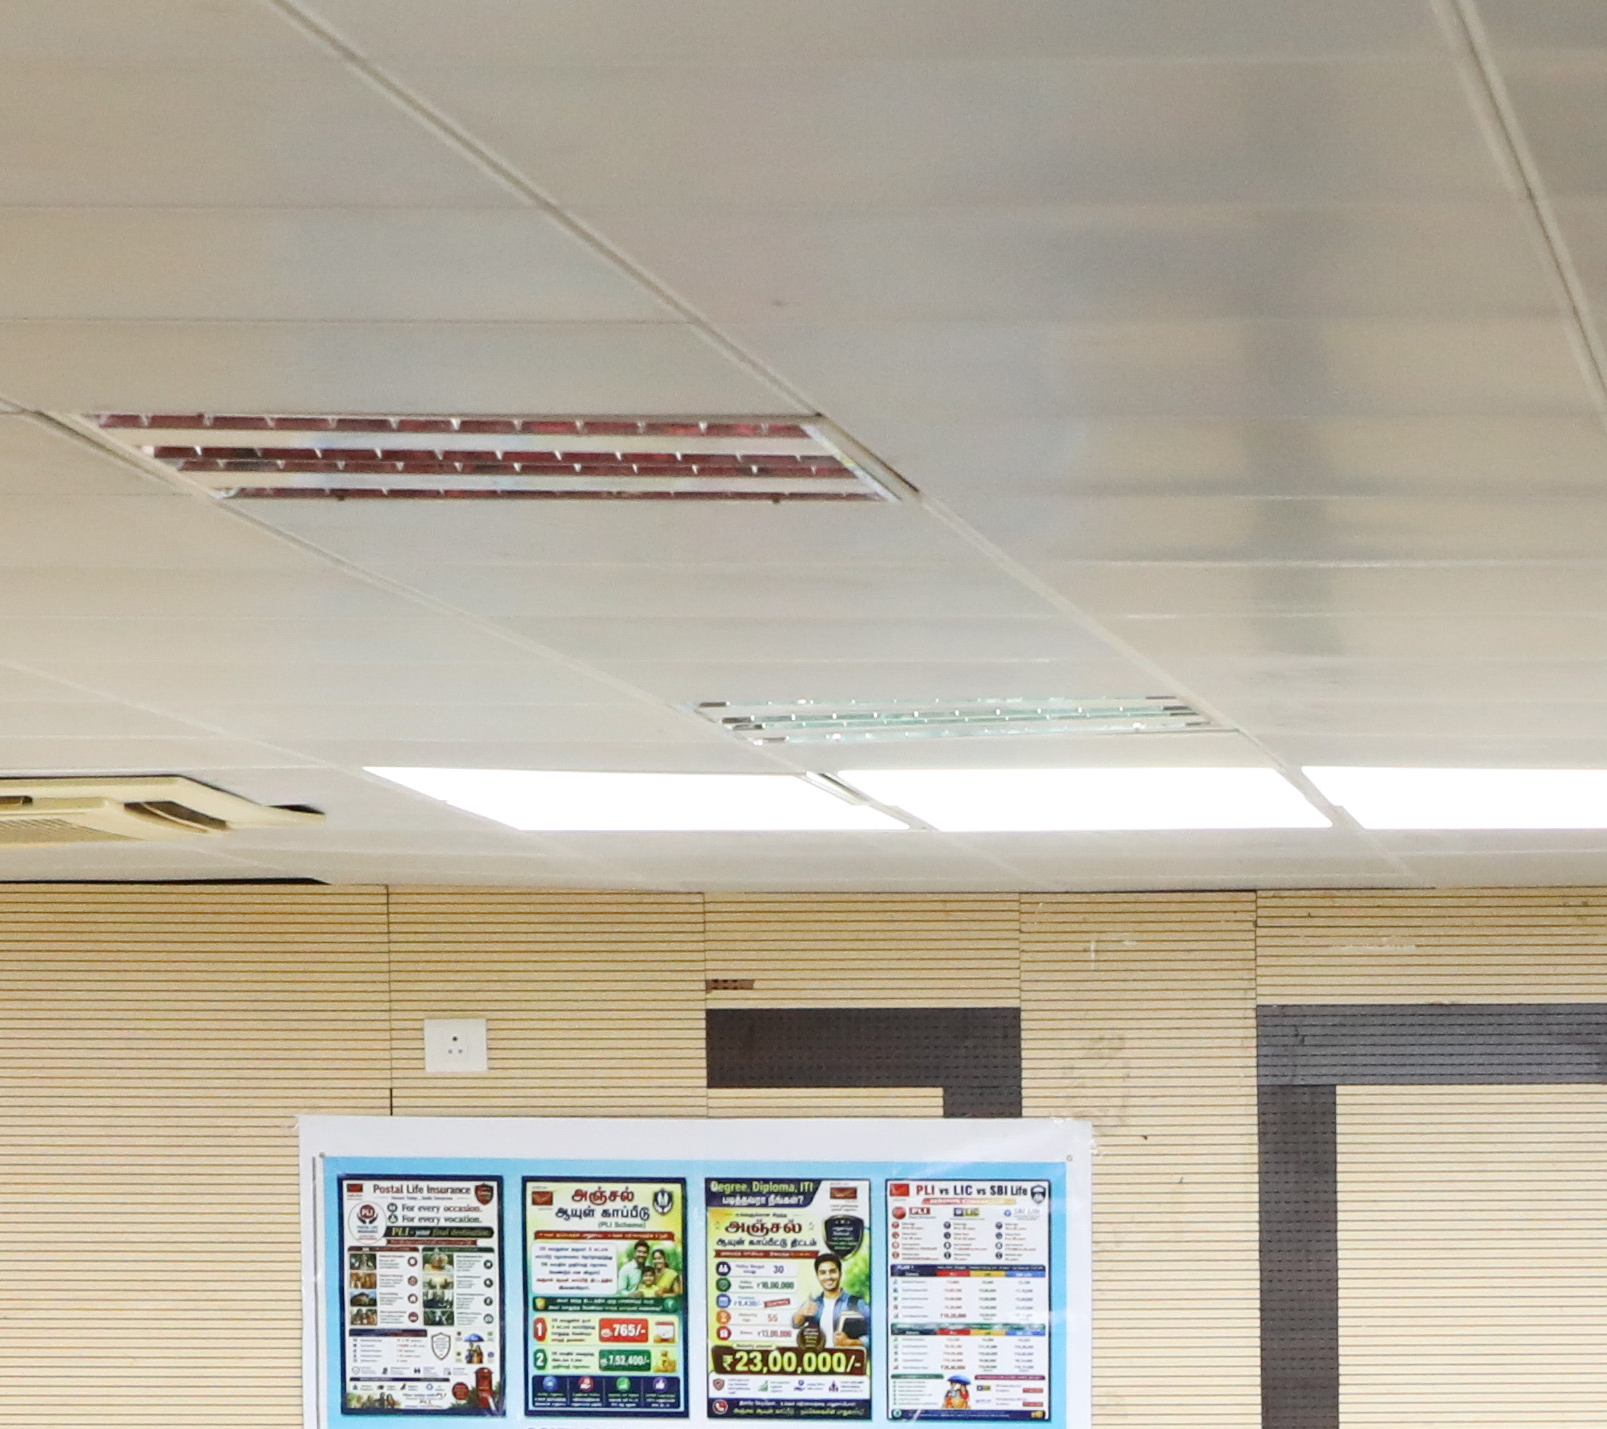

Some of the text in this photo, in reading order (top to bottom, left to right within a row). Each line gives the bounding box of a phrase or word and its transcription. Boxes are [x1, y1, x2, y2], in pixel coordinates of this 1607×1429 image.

[373, 1184, 471, 1194] Postal Life Insurance
[800, 1181, 813, 1192] ITI
[916, 1185, 1028, 1196] PLI vs LIC vs SBI Life
[571, 1186, 635, 1206] அஞ்சல்
[402, 1204, 415, 1212] For
[418, 1205, 440, 1214] every
[555, 1205, 651, 1221] ஆயுள் காப்பீடு
[402, 1215, 415, 1223] For
[418, 1216, 440, 1225] every
[725, 1218, 802, 1237] அஞ்சல்
[716, 1237, 745, 1248] ஆயுள்
[791, 1237, 817, 1248] திட்டம்
[773, 1265, 784, 1274] 30
[536, 1323, 542, 1336] 1
[536, 1353, 544, 1366] 2
